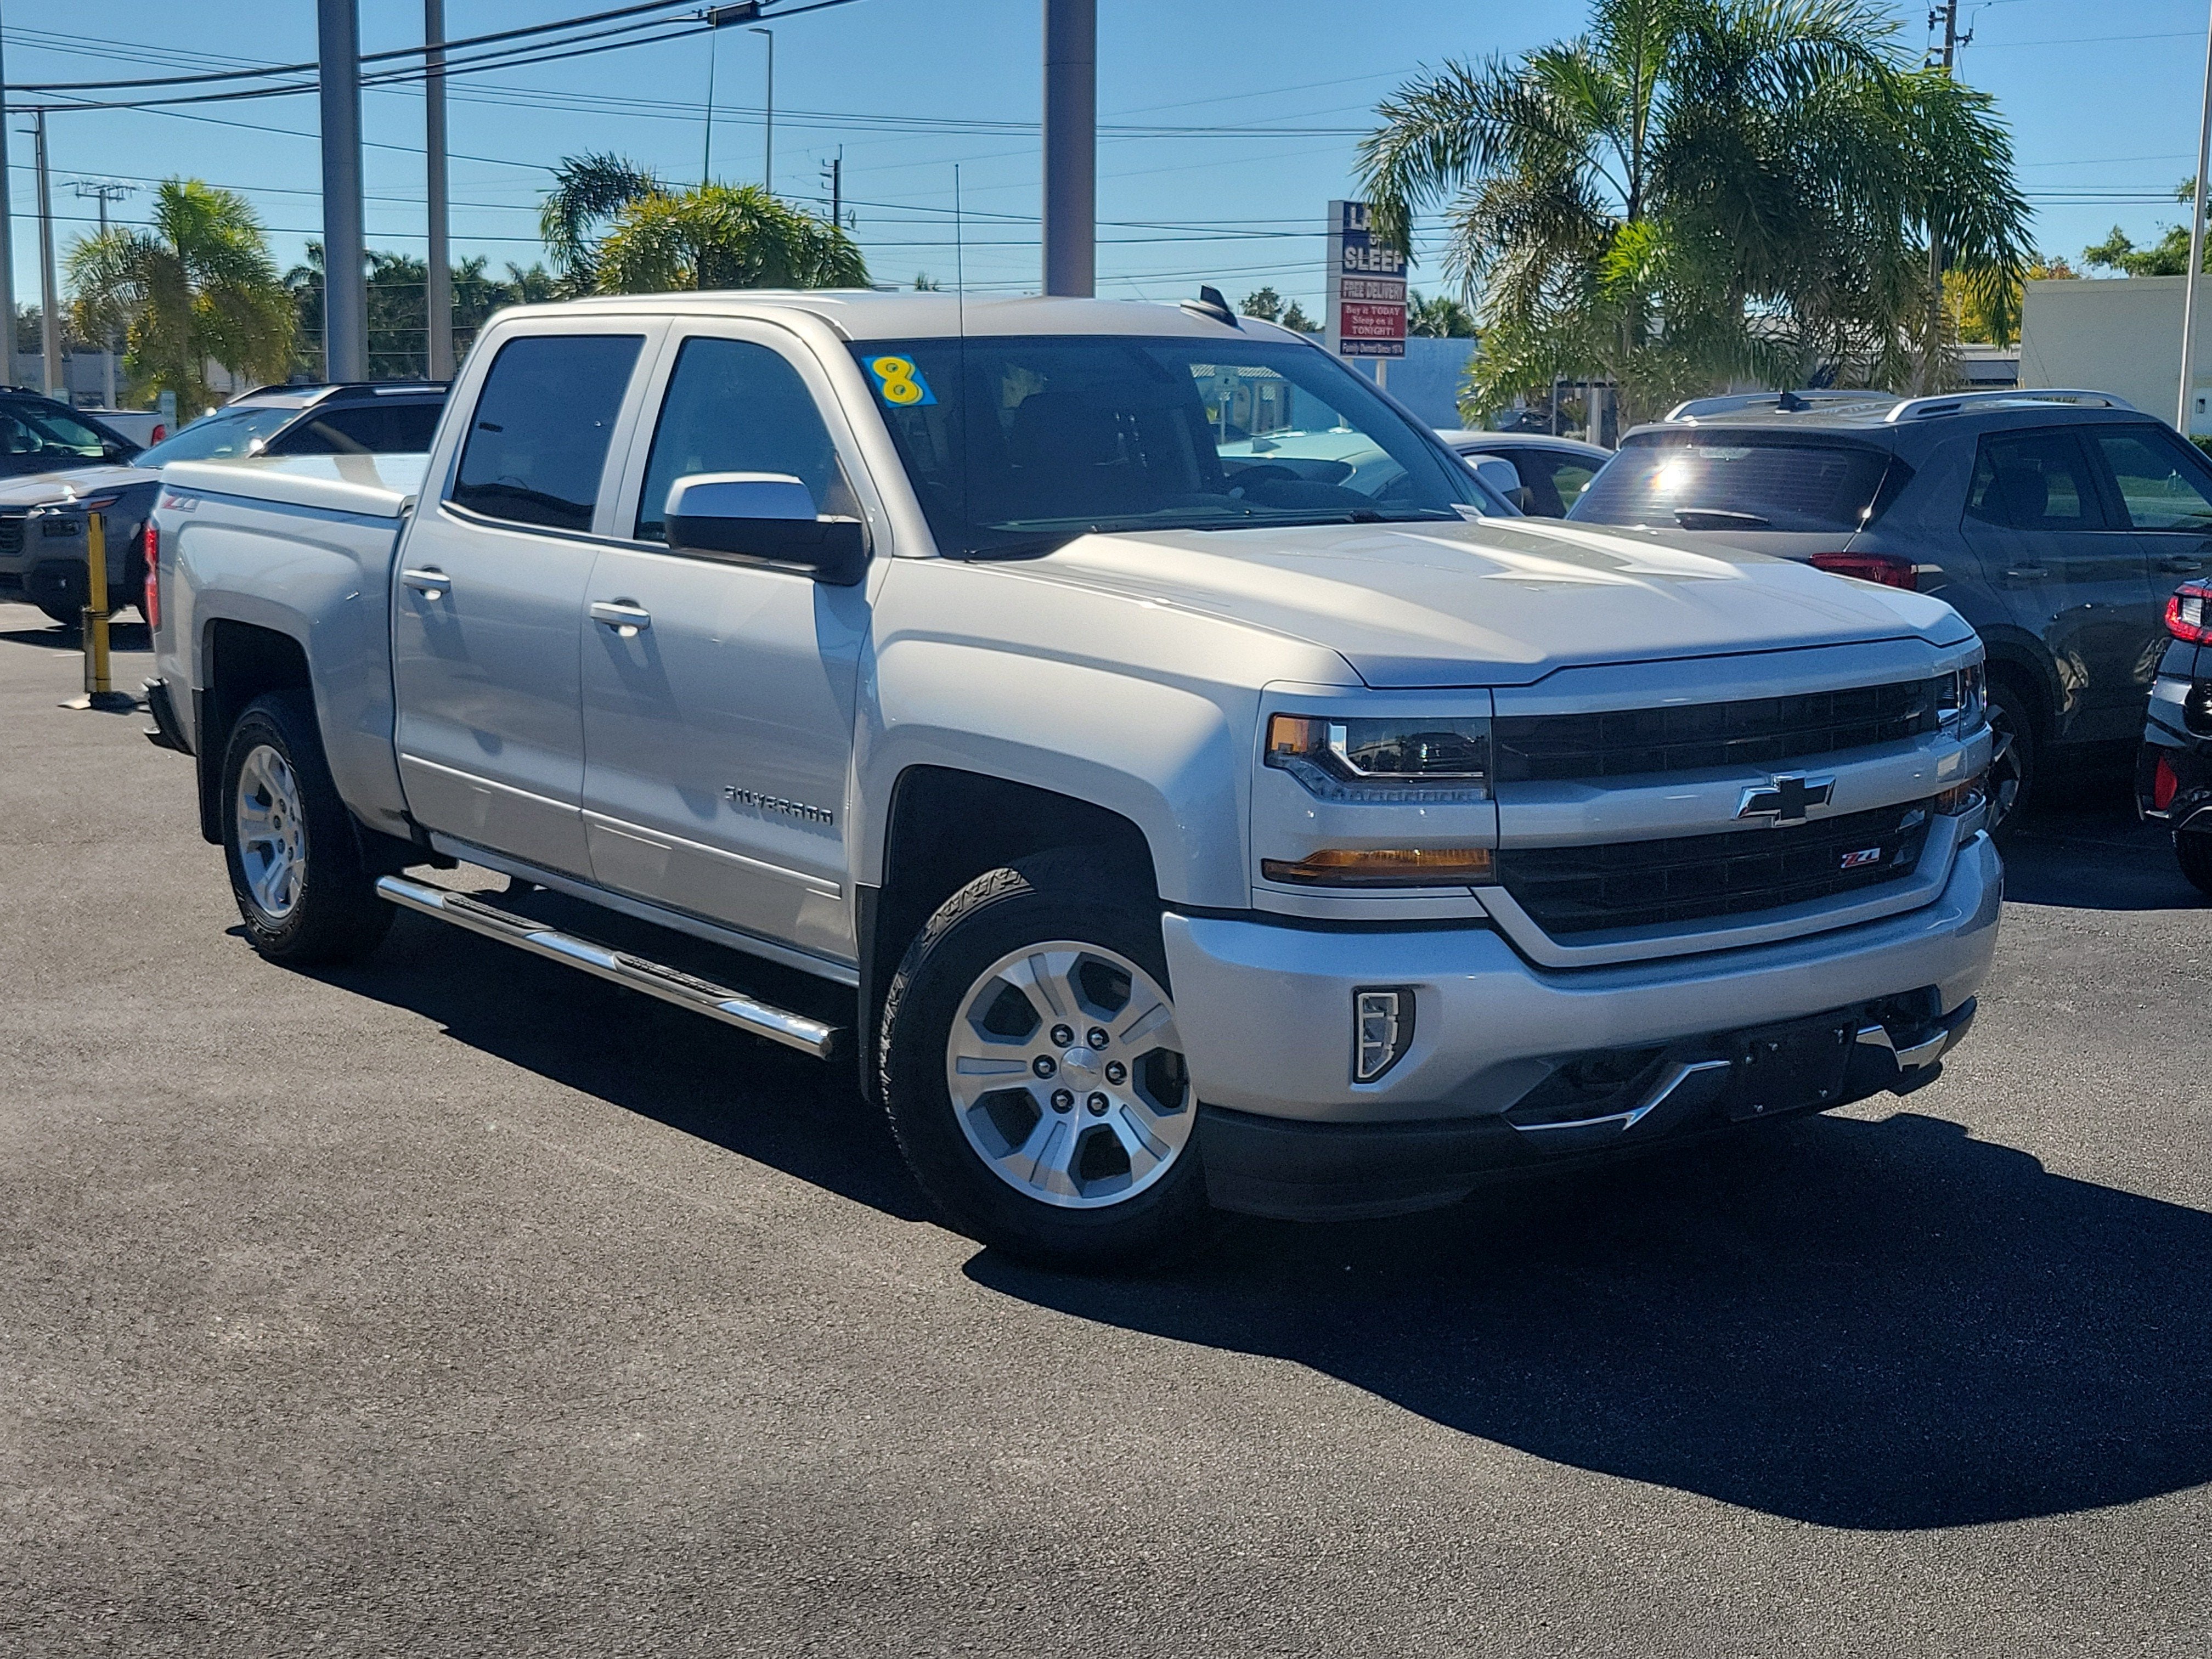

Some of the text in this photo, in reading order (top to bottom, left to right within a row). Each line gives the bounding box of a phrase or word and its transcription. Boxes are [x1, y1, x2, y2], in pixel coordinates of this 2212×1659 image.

[1345, 246, 1404, 272] SLEEP
[1343, 280, 1404, 301] FREE DELIVERY
[1346, 304, 1361, 315] Buy
[1371, 306, 1401, 316] TODAY
[1352, 315, 1374, 326] Sleep
[1351, 326, 1395, 336] TONIGHT!
[872, 357, 924, 405] 8
[1841, 847, 1881, 868] Z71
